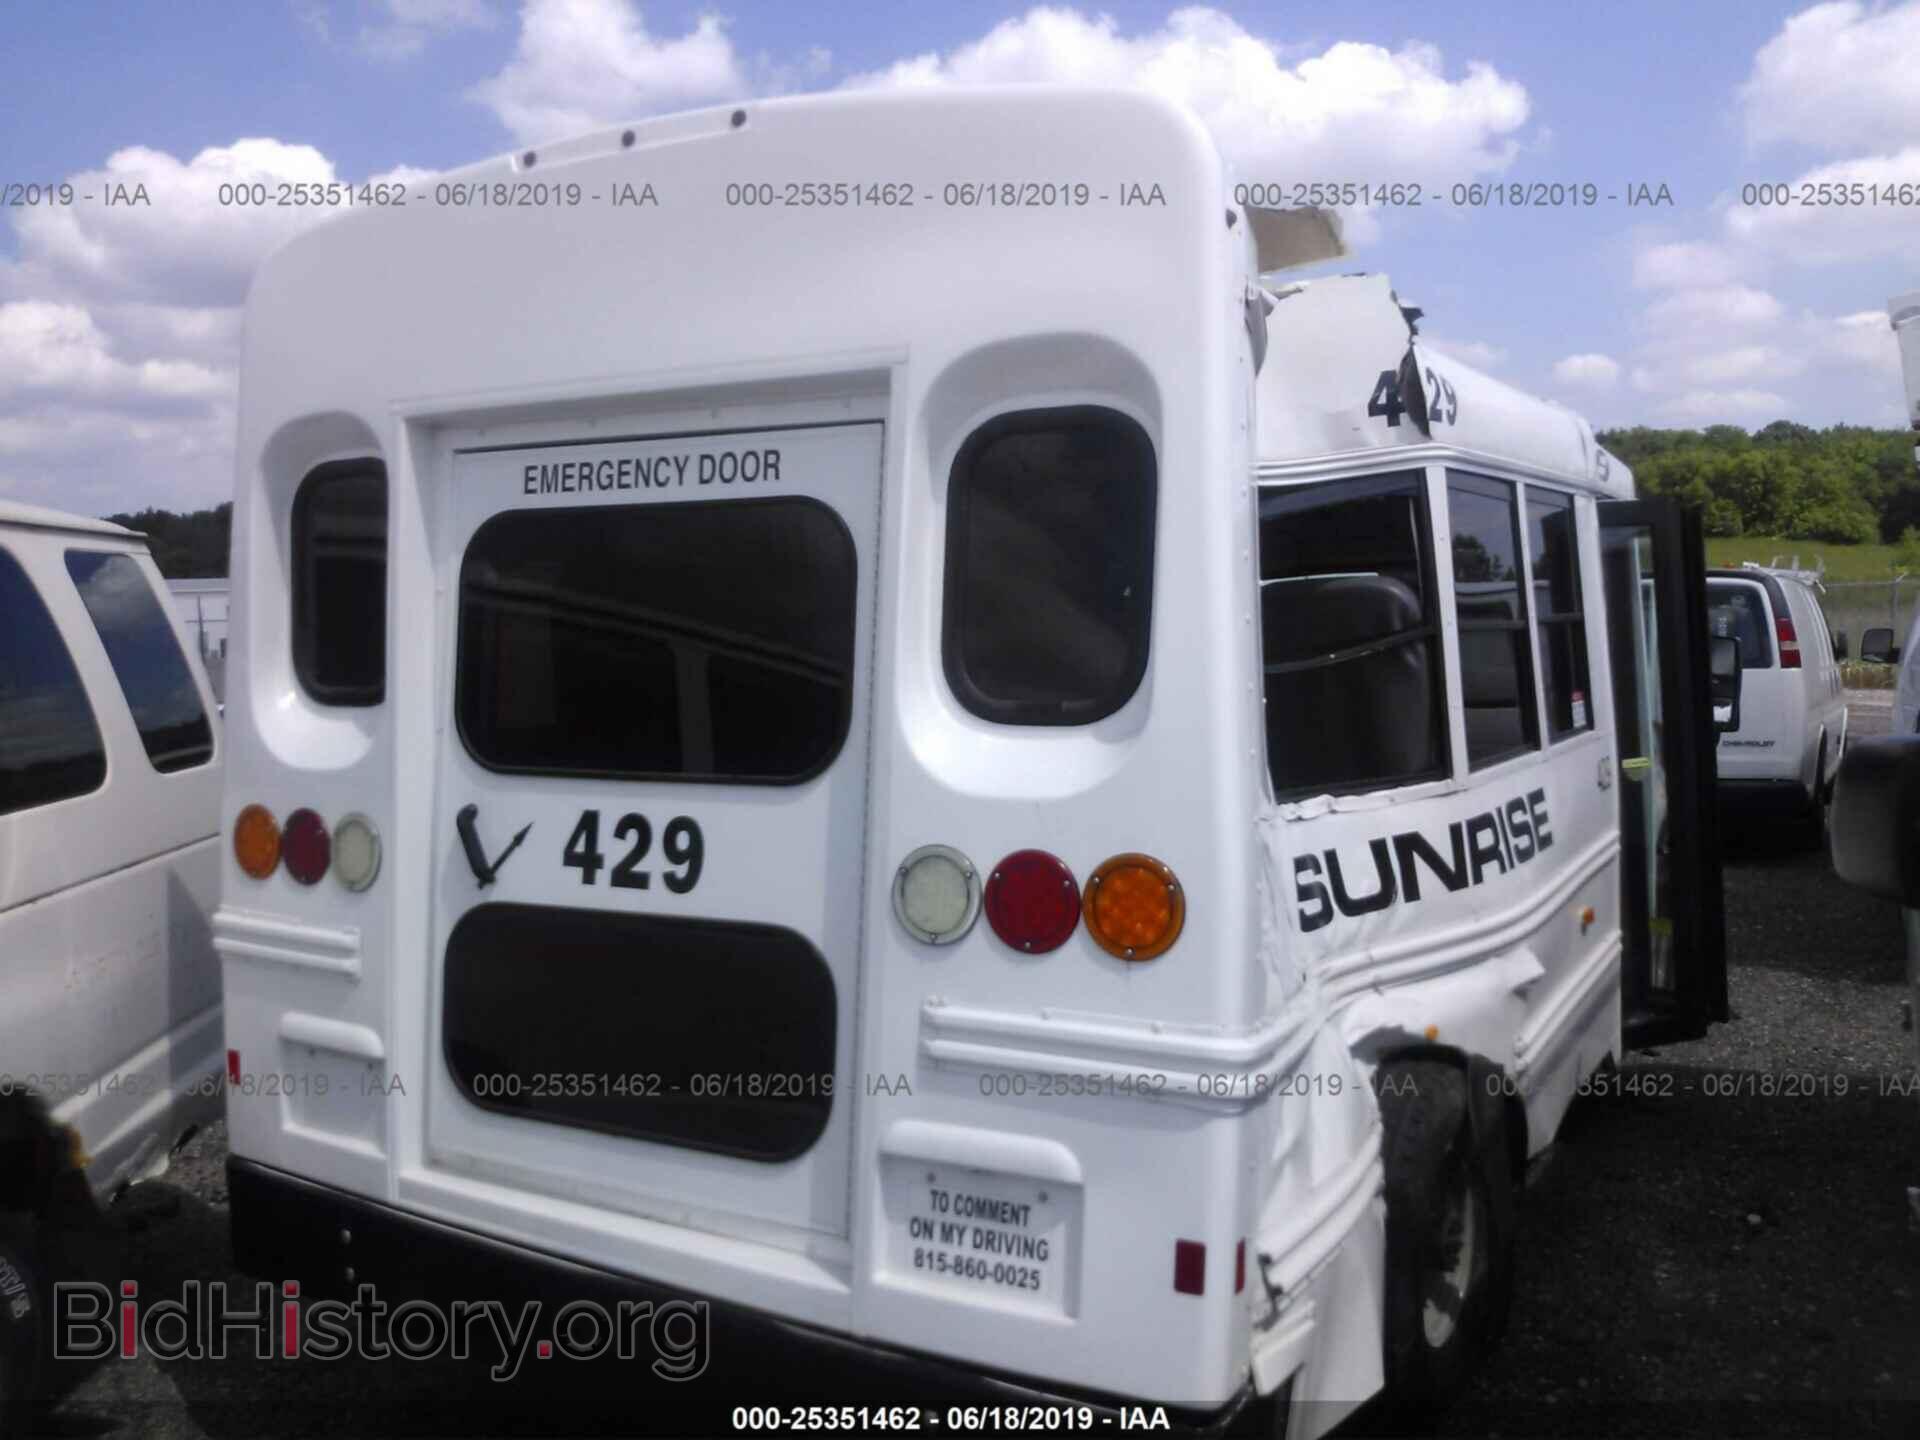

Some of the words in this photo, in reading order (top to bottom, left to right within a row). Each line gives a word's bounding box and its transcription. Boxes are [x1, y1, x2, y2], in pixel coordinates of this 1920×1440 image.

[523, 455, 690, 495] EMERGENCY
[698, 449, 781, 485] DOOR
[562, 809, 705, 894] 429
[1293, 787, 1554, 934] SUNRISE
[929, 1189, 950, 1214] TO
[953, 1193, 1031, 1228] COMMENT
[909, 1216, 935, 1241] ON
[940, 1221, 968, 1246] MY
[971, 1227, 1049, 1262] DRIVING
[913, 1247, 1041, 1291] 815-860-0025
